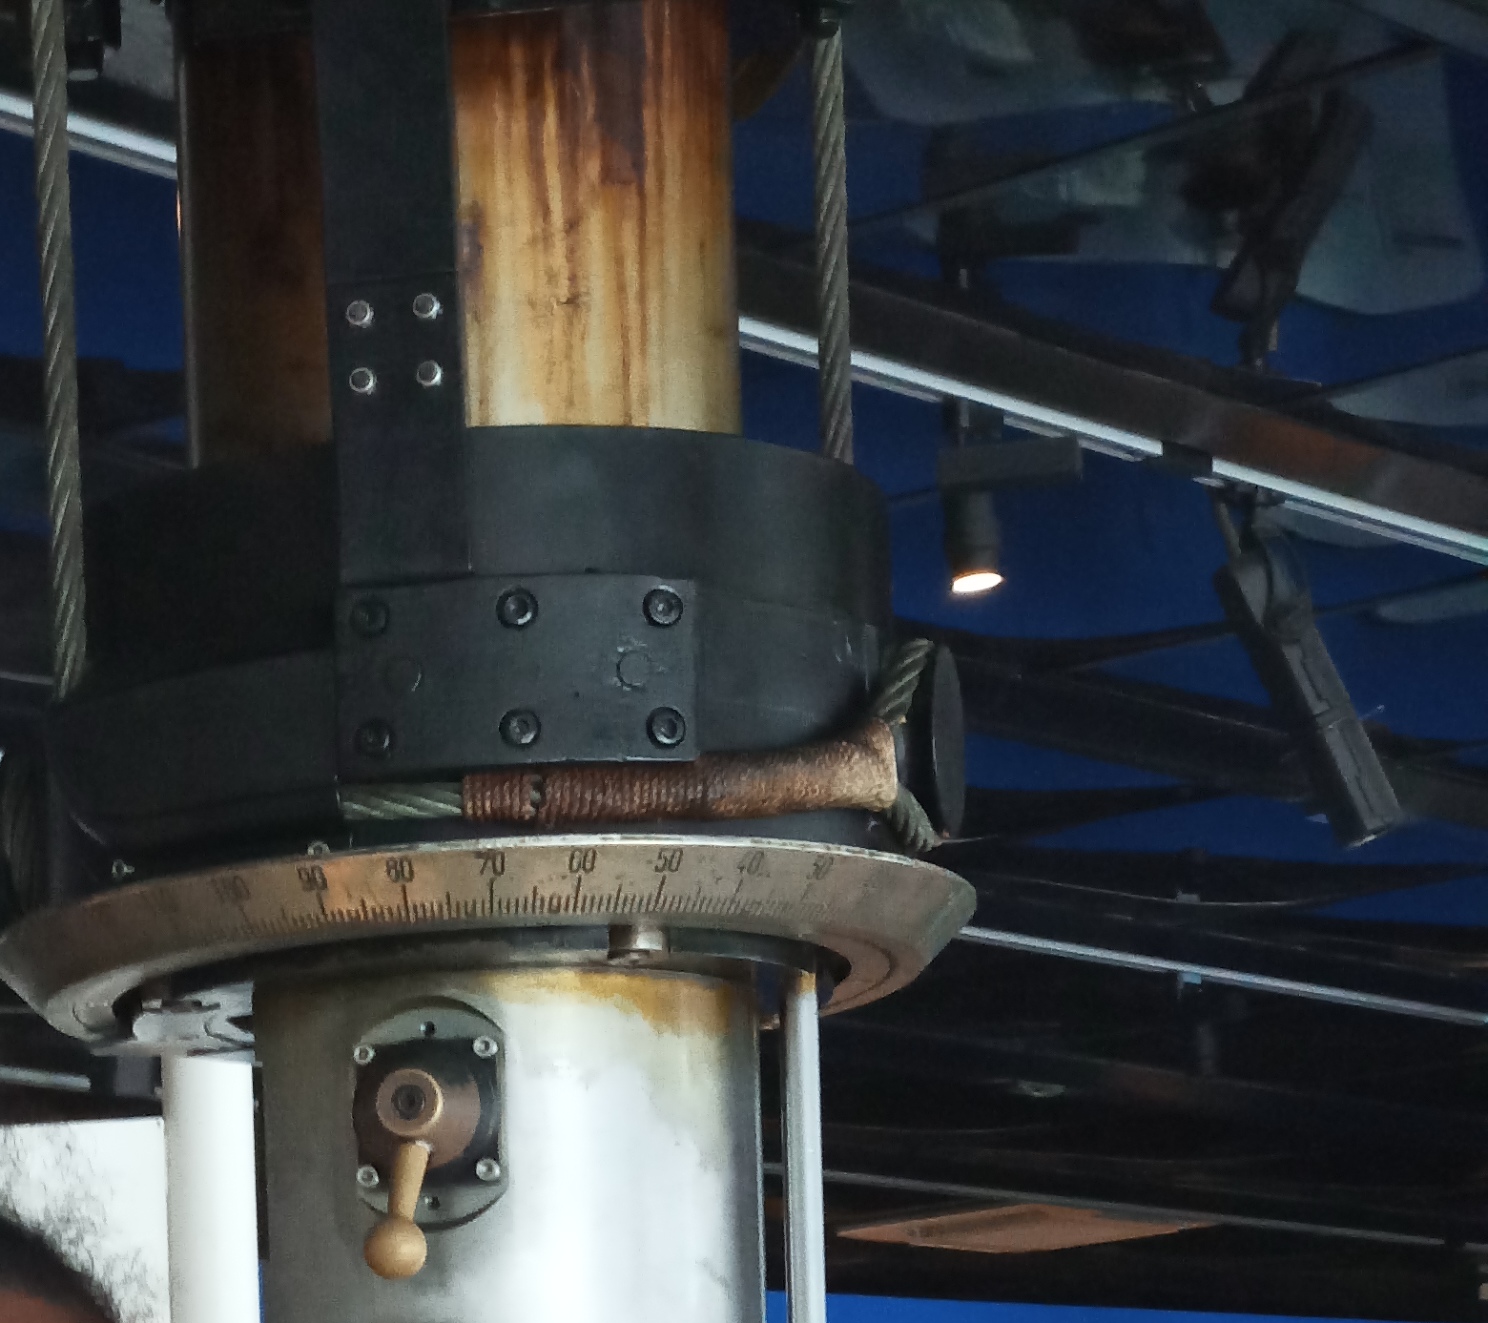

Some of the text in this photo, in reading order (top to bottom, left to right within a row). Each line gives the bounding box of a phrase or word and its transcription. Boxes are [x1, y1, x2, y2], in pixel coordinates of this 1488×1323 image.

[298, 864, 328, 892] 90
[385, 856, 415, 883] 80
[475, 849, 505, 877] 70
[568, 849, 598, 873] 60
[654, 849, 683, 872] 50
